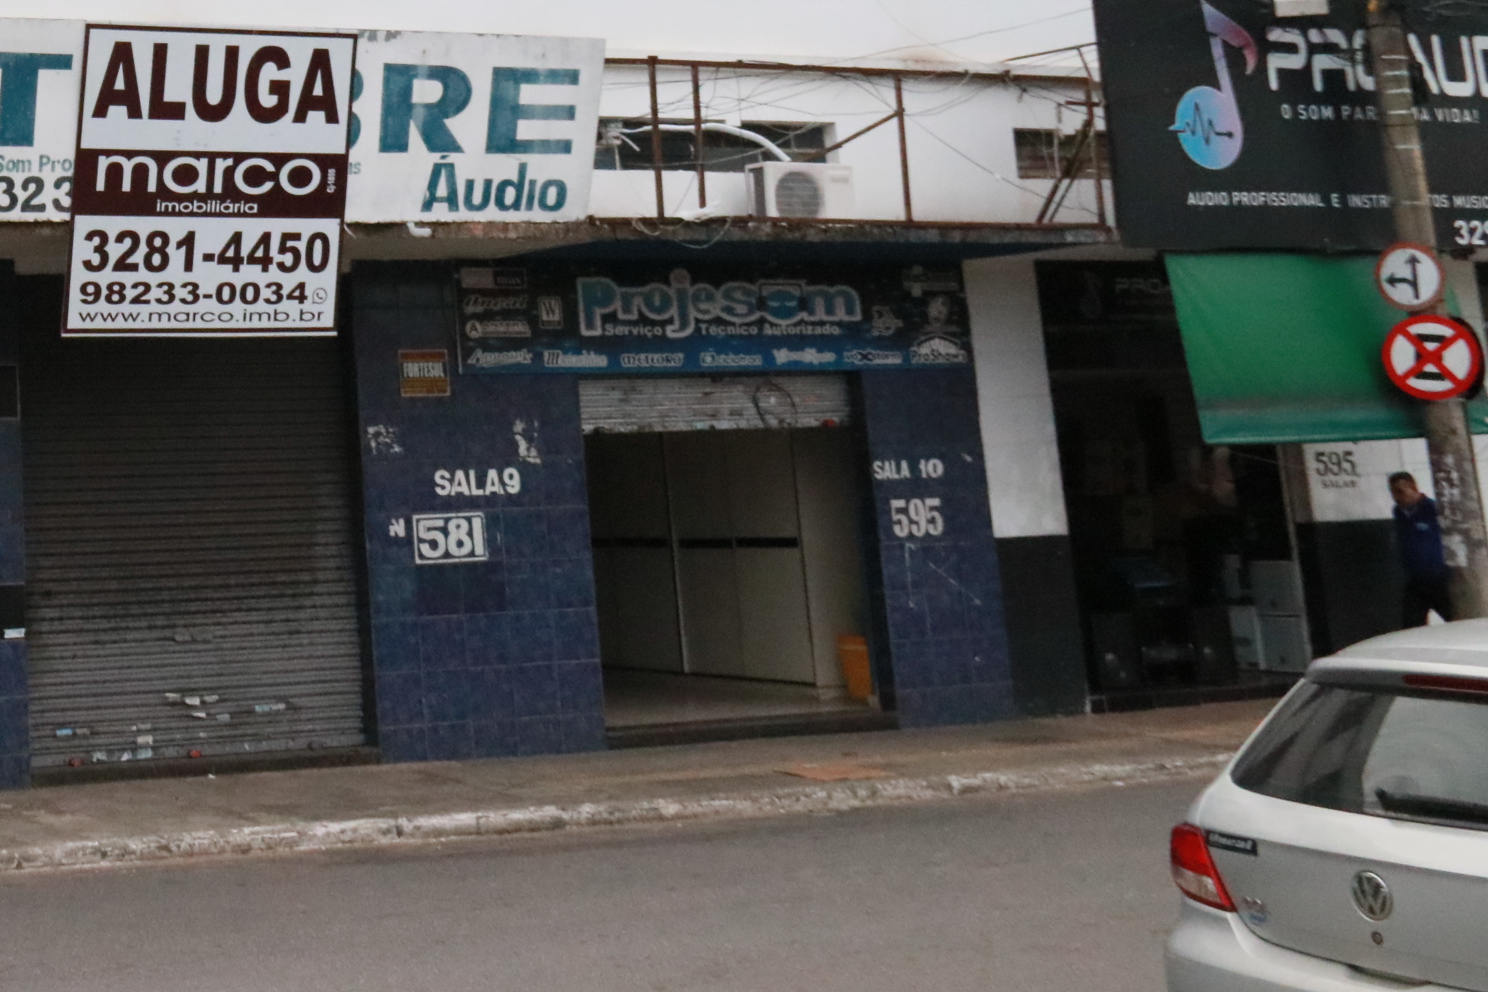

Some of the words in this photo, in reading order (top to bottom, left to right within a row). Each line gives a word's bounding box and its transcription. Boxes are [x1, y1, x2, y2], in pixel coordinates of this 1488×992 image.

[92, 41, 339, 125] ALUGA
[1298, 104, 1334, 120] SOM
[1341, 106, 1380, 121] PAR
[96, 155, 321, 196] marco
[420, 155, 567, 212] Áudio
[156, 199, 258, 214] imobiliária
[1187, 191, 1227, 206] AUDIO
[1232, 192, 1324, 207] PROFISSIONAL
[1331, 194, 1342, 208] E
[82, 229, 330, 273] 3281-4450
[79, 281, 308, 306] 98233-0034
[79, 309, 324, 323] www.marco.imb.br
[604, 324, 663, 338] Serviço
[762, 323, 841, 336] Autorizado
[872, 459, 911, 480] SALA
[919, 458, 944, 479] 10
[889, 497, 944, 538] 595
[417, 516, 486, 558] 581
